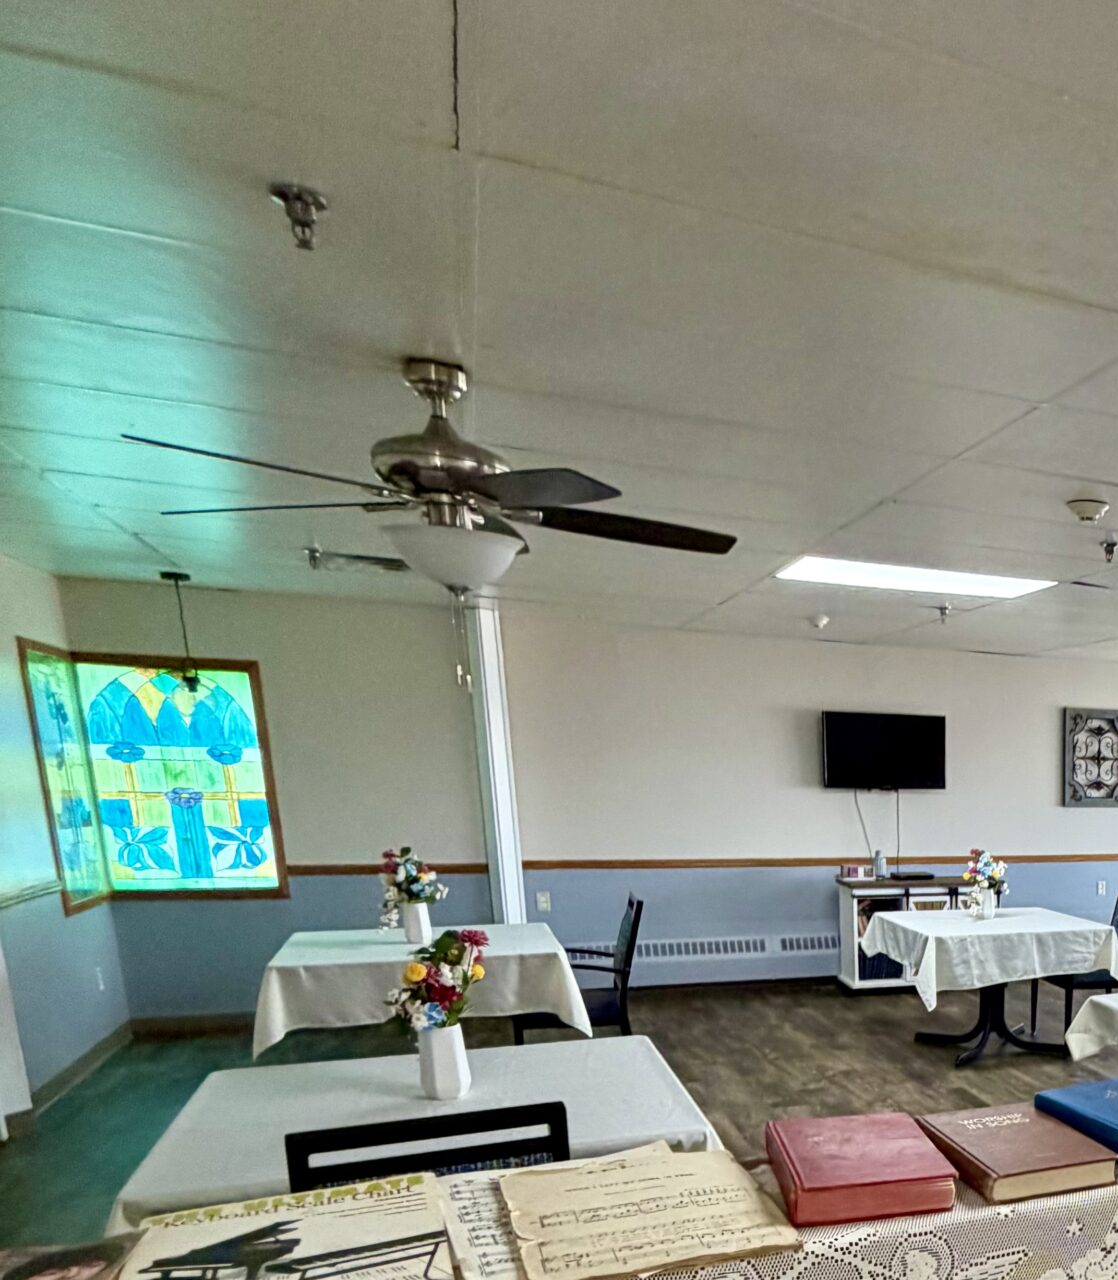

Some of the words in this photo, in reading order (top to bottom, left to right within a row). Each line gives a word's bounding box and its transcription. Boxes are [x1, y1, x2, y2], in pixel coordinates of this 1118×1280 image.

[959, 1113, 1022, 1124] WORSHIP
[986, 1118, 1030, 1128] SONG
[352, 1184, 413, 1202] Chart
